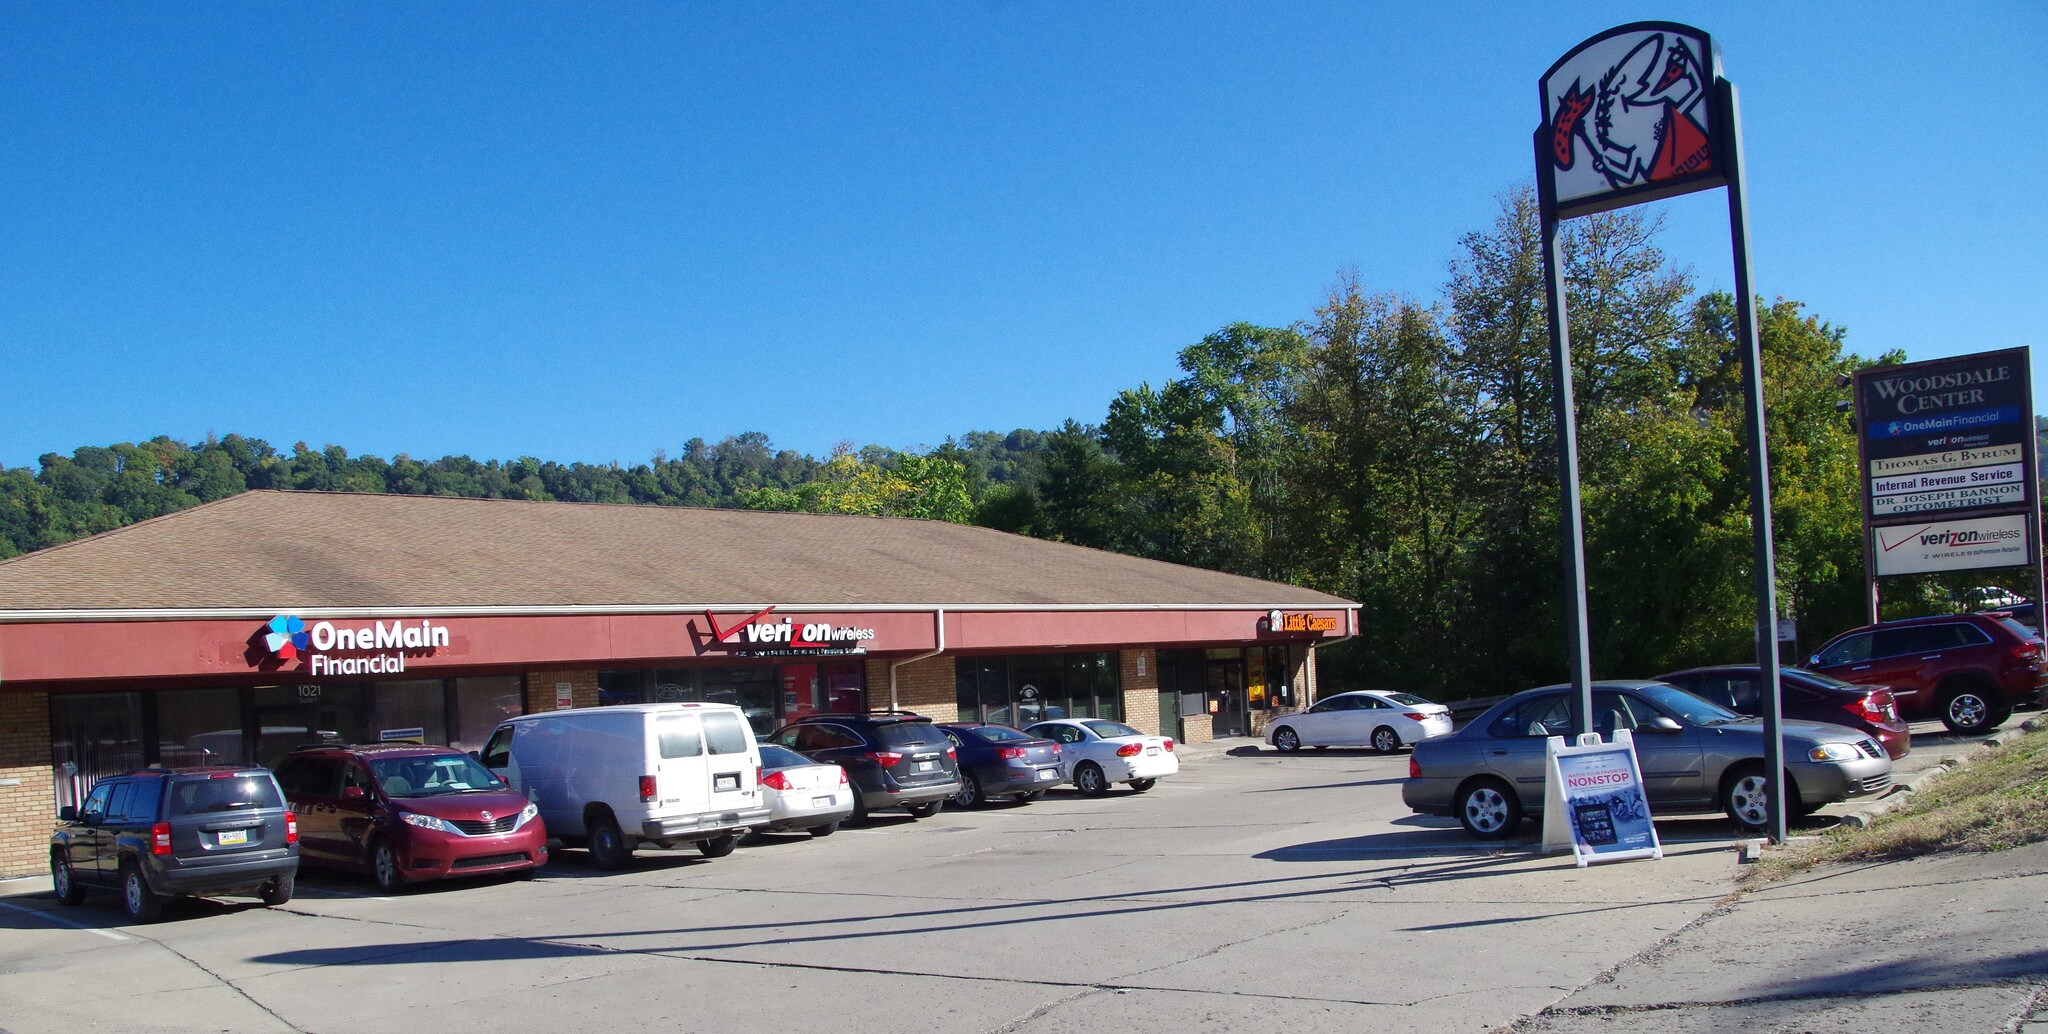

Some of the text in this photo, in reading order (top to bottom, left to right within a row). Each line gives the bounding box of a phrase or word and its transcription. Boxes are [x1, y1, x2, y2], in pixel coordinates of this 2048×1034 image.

[1872, 366, 2010, 399] WOODSDALE
[1897, 389, 1985, 414] CENTER
[1875, 448, 2017, 471] THOMAS G. BYRUM
[1876, 470, 2013, 492] Internal Revenue Service
[1876, 485, 2020, 506] DR. JOSEPH BANNON
[1893, 496, 2003, 512] OPTOMETRIST
[1283, 614, 1336, 631] Little Caesars
[312, 620, 449, 650] OneMain
[311, 652, 404, 676] Financial
[298, 685, 321, 697] 1021
[1568, 773, 1629, 787] NONSTOP
